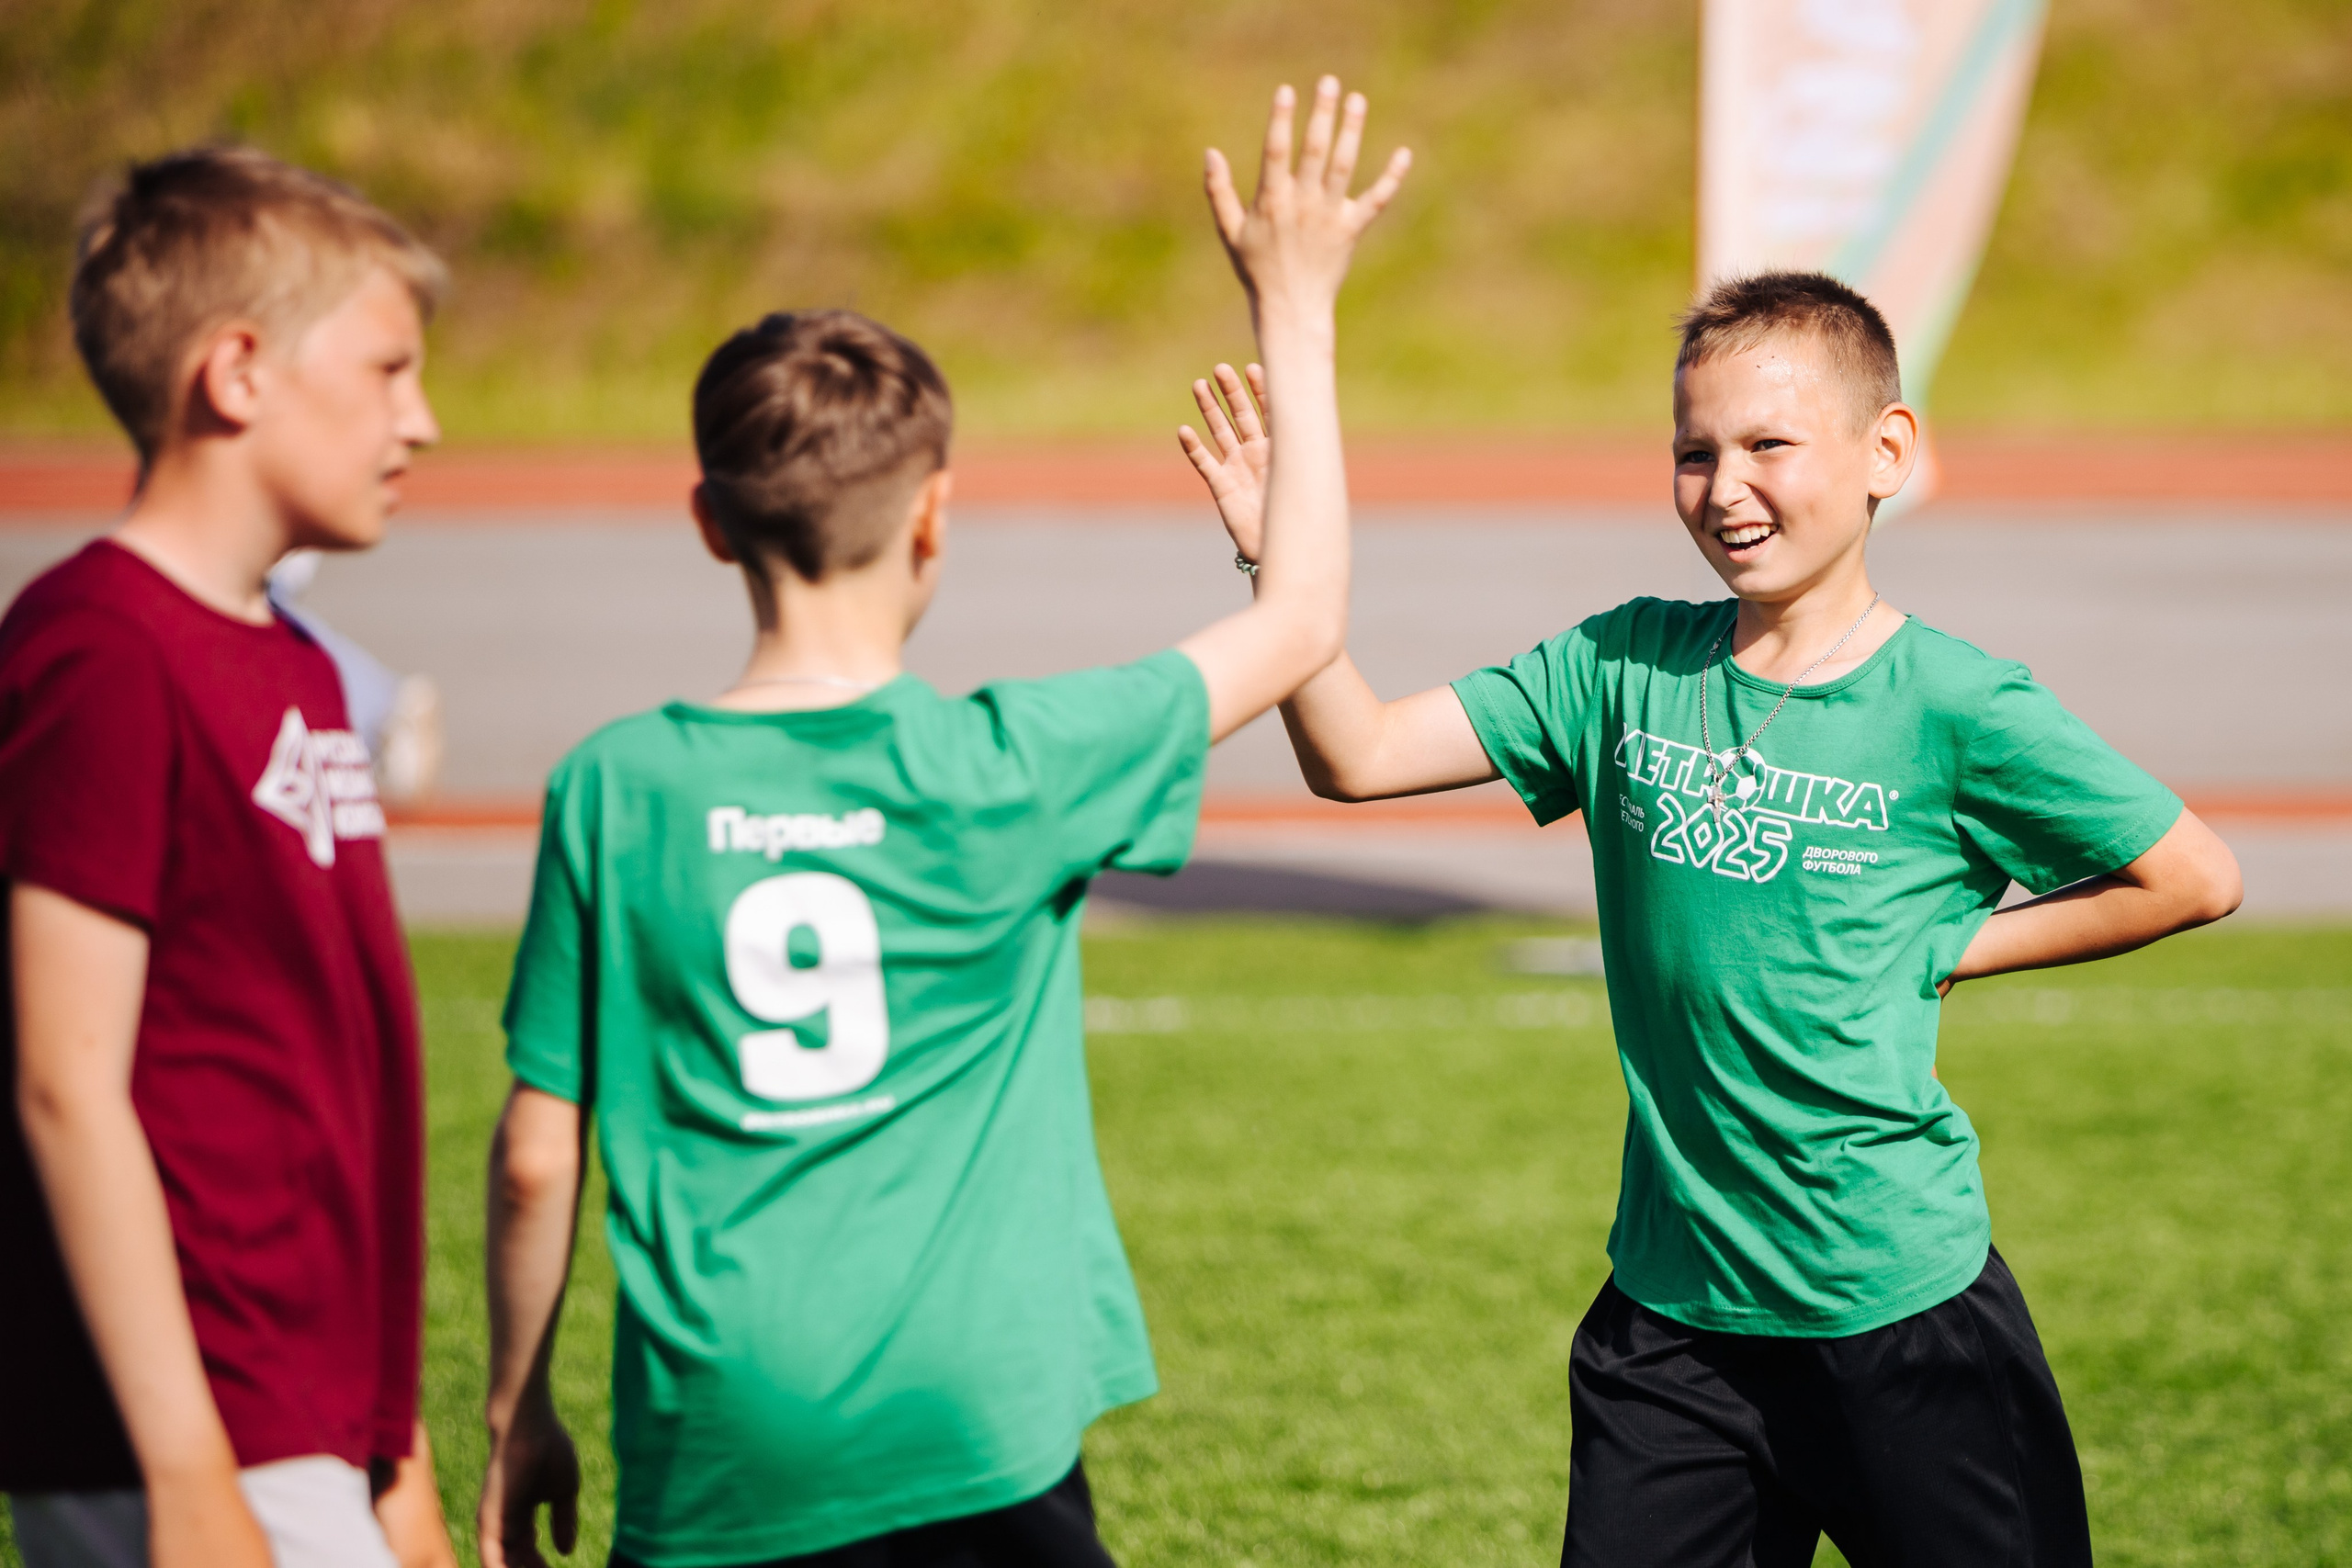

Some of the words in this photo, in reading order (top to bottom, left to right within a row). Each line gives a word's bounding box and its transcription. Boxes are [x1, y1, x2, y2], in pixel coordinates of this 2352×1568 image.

[1651, 792, 1792, 884] 2025
[1802, 846, 1879, 863] ДВОРОВОГО
[1802, 860, 1861, 875] ФУТБОЛА
[723, 871, 889, 1102] 9
